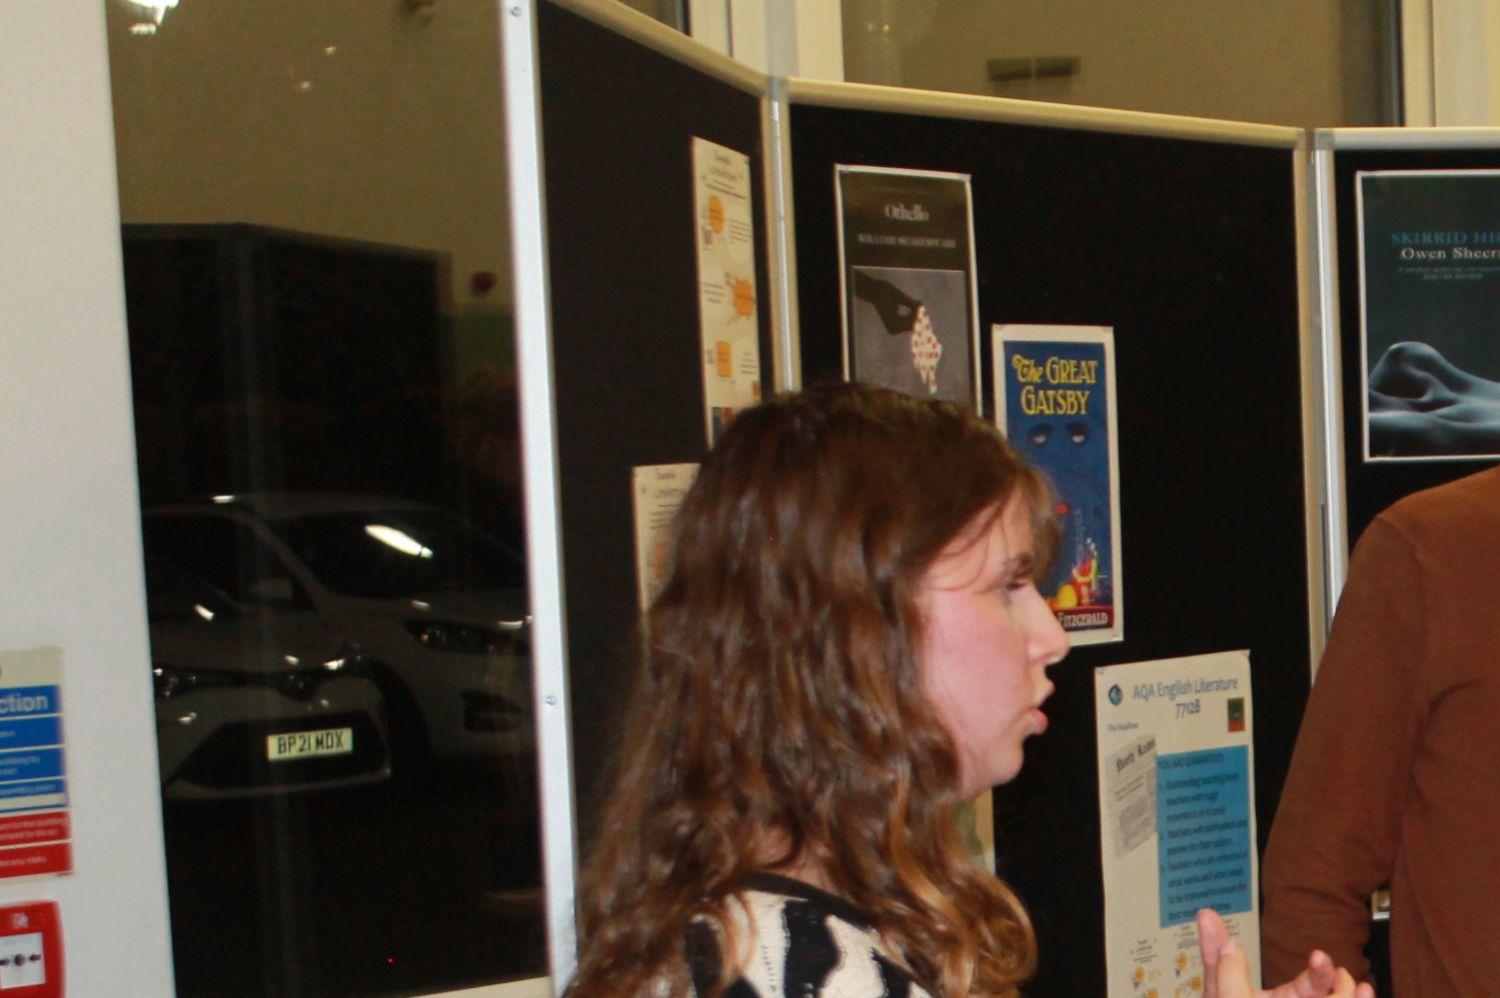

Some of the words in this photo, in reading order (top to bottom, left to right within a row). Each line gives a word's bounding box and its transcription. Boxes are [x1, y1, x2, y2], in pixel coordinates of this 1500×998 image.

[884, 202, 930, 222] Othello
[1392, 231, 1468, 246] SKIRRID
[1401, 247, 1447, 260] Owen
[1011, 354, 1044, 383] The
[1045, 356, 1099, 385] GREAT
[1020, 385, 1091, 416] GATSBY
[1132, 683, 1156, 702] AQA
[1157, 681, 1193, 701] English
[1194, 679, 1239, 693] Literature
[0, 693, 48, 713] ction
[277, 734, 312, 754] BP21
